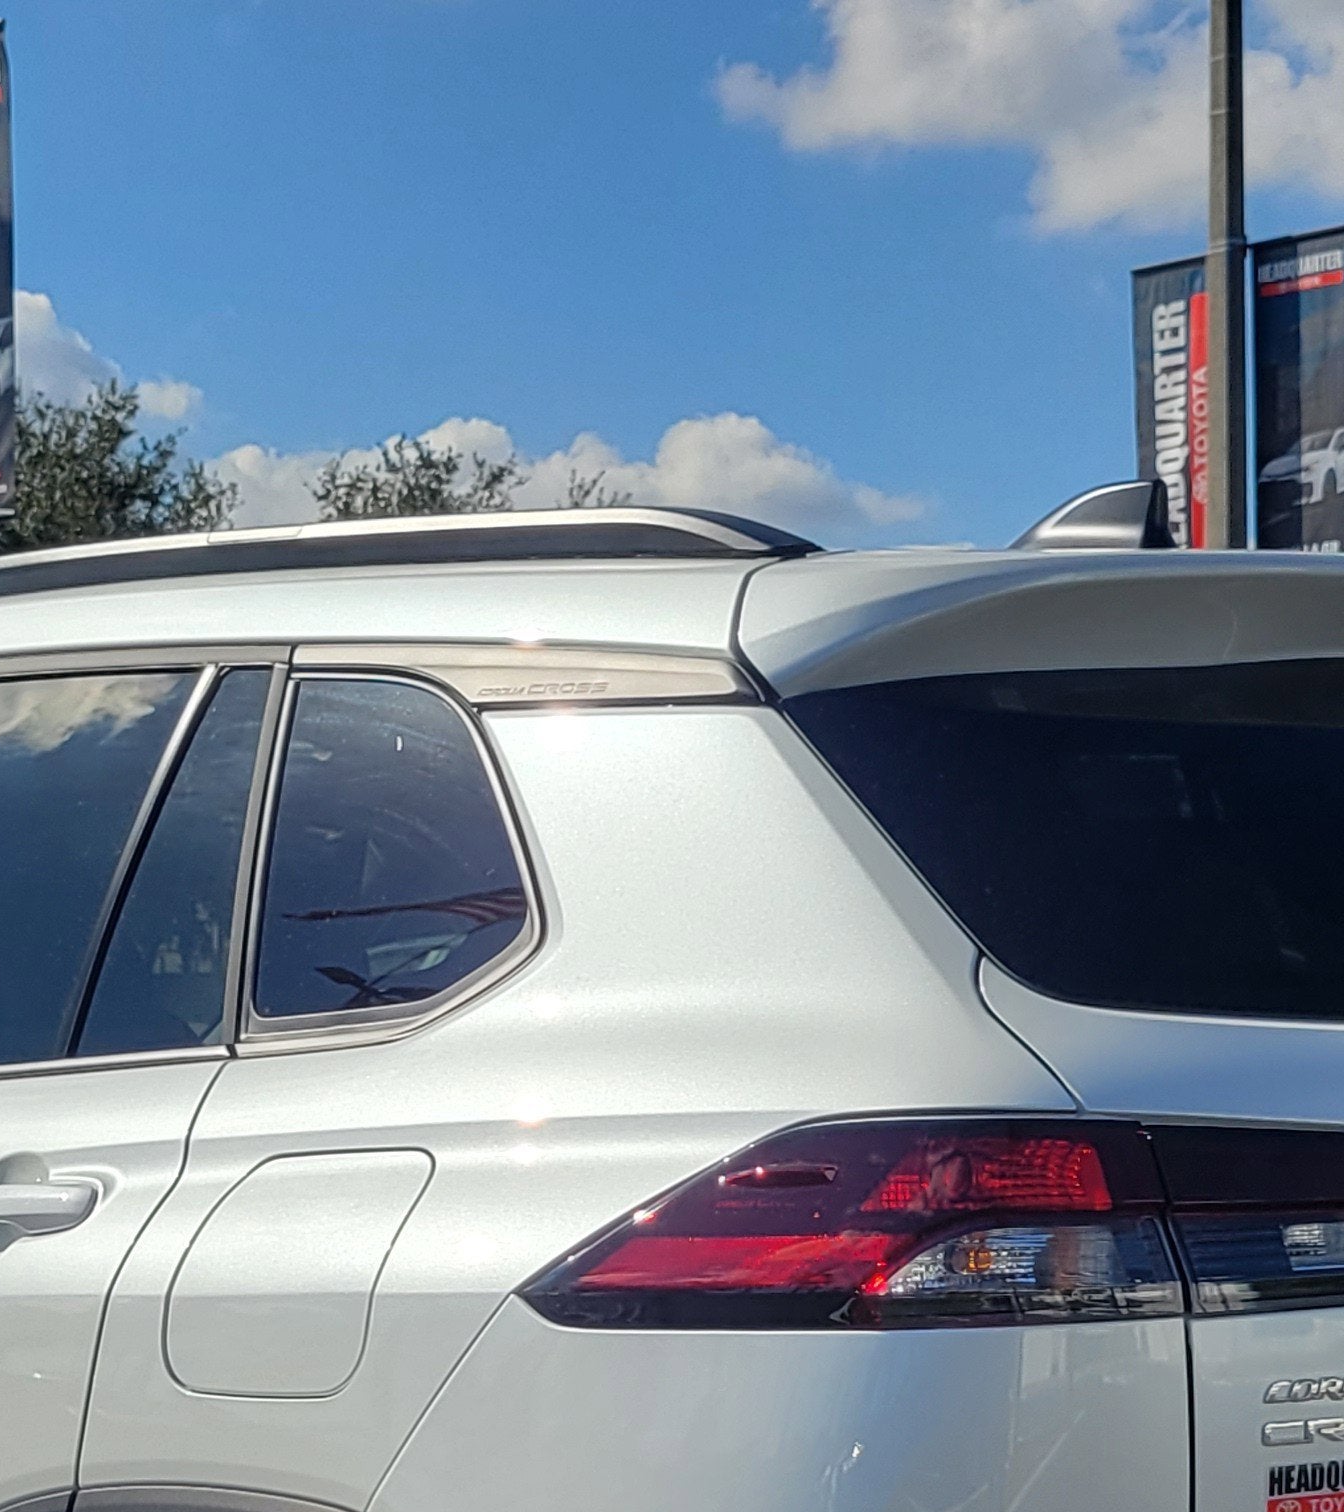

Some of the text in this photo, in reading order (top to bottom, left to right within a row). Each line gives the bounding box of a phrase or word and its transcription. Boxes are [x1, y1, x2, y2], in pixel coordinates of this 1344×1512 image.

[1152, 299, 1189, 549] EADQUARTER
[1191, 365, 1209, 475] TOYOTA
[527, 682, 610, 695] CROSS
